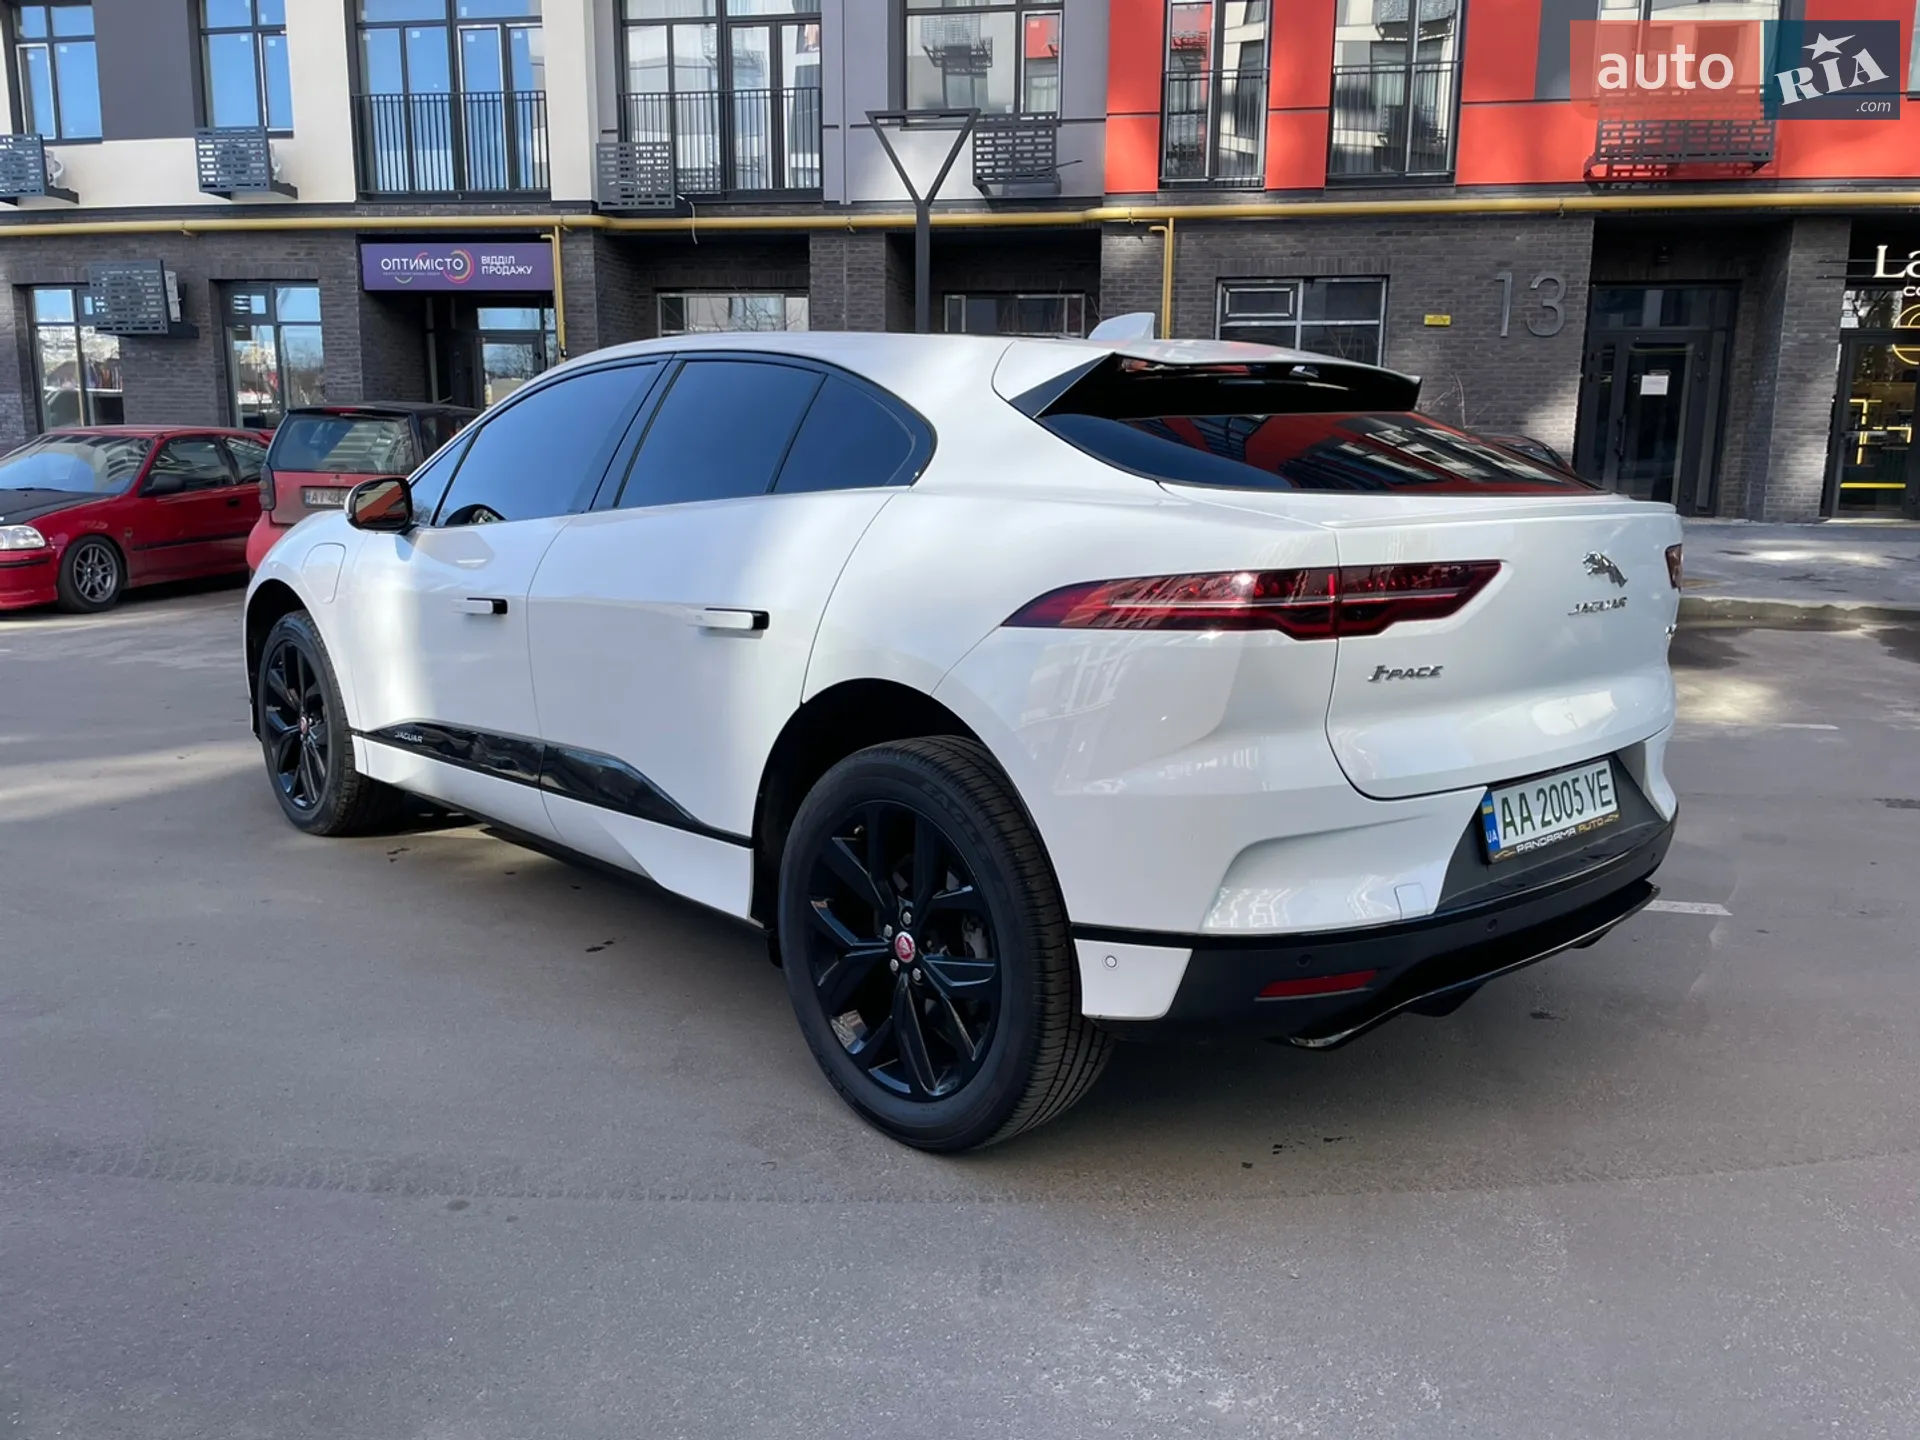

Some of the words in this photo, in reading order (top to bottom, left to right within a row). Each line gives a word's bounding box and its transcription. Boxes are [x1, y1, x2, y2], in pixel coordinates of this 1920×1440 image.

[381, 258, 464, 271] ОПТИМІСТО
[481, 255, 516, 265] ВІДДІЛ
[481, 265, 533, 276] ПРОДАЖУ
[1494, 271, 1567, 338] 13
[1567, 596, 1628, 616] JAGUAR
[394, 731, 424, 743] JAGUAR
[1500, 791, 1536, 841] AA
[1536, 775, 1584, 829] 2005
[1584, 767, 1613, 812] YE
[1485, 829, 1499, 844] UA
[1515, 826, 1577, 854] PANORAMA
[1578, 817, 1604, 834] AUTO
